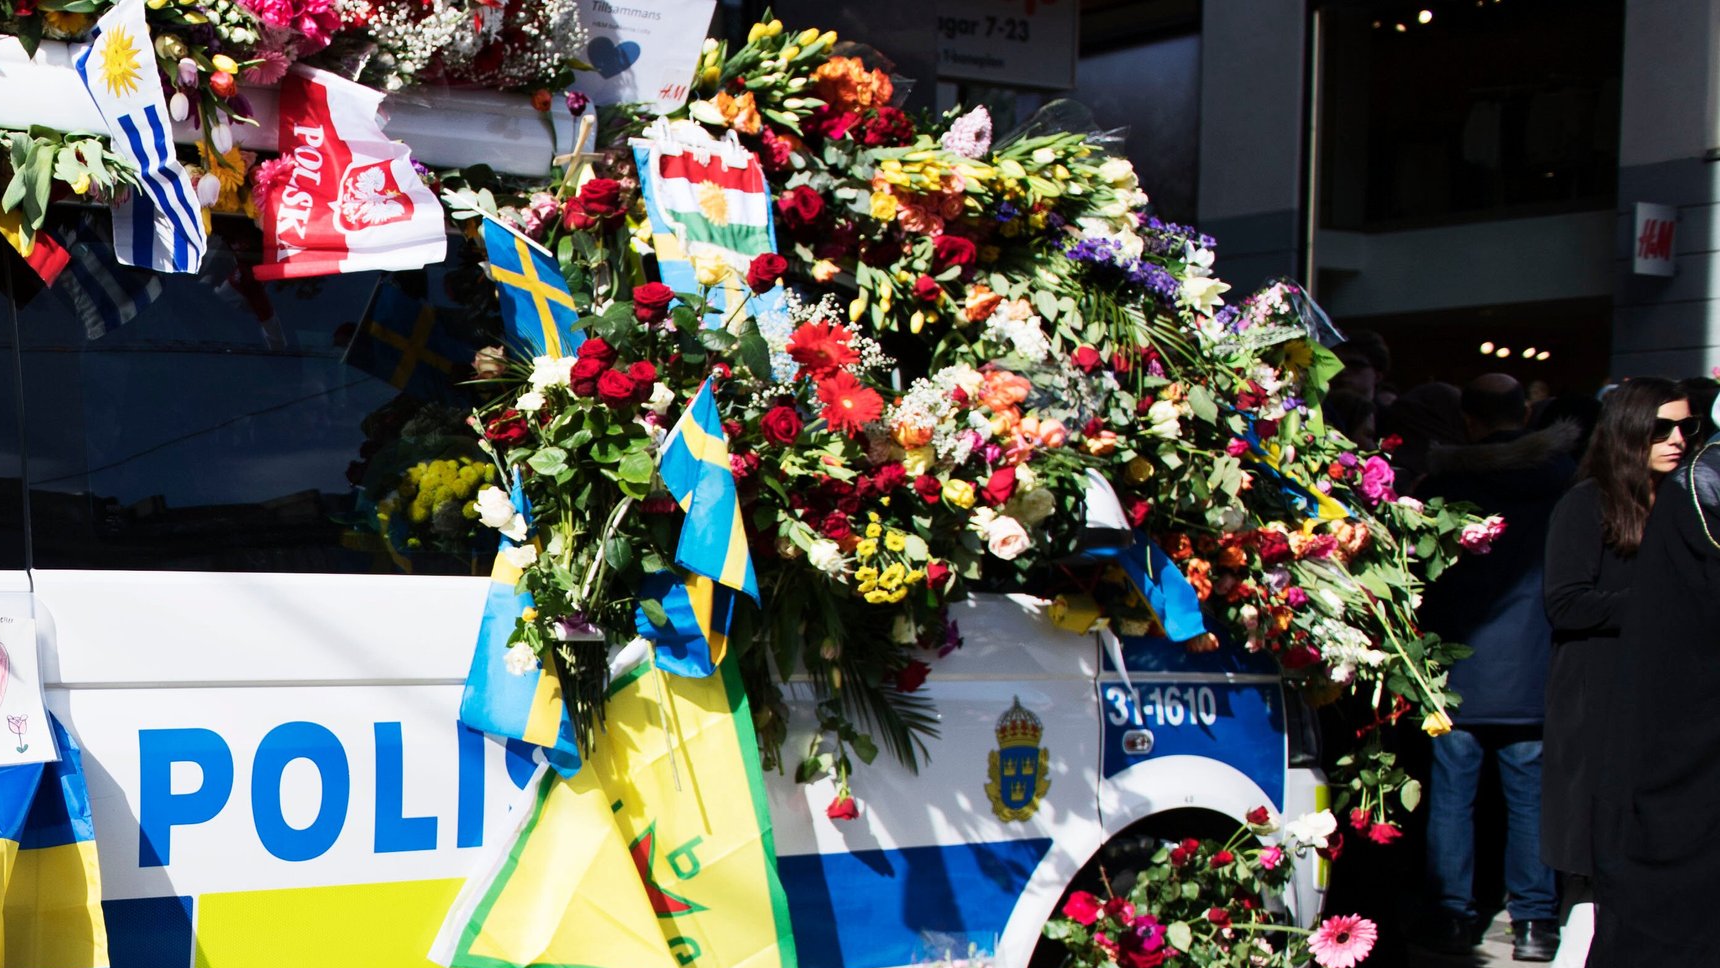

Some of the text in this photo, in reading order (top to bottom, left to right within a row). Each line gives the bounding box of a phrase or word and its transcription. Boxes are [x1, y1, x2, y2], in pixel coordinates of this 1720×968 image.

[591, 1, 662, 20] Tillsammans
[985, 15, 1030, 42] 7-23
[276, 122, 324, 262] POLSKA
[1638, 218, 1675, 262] H&M
[1106, 686, 1217, 726] 31-1610
